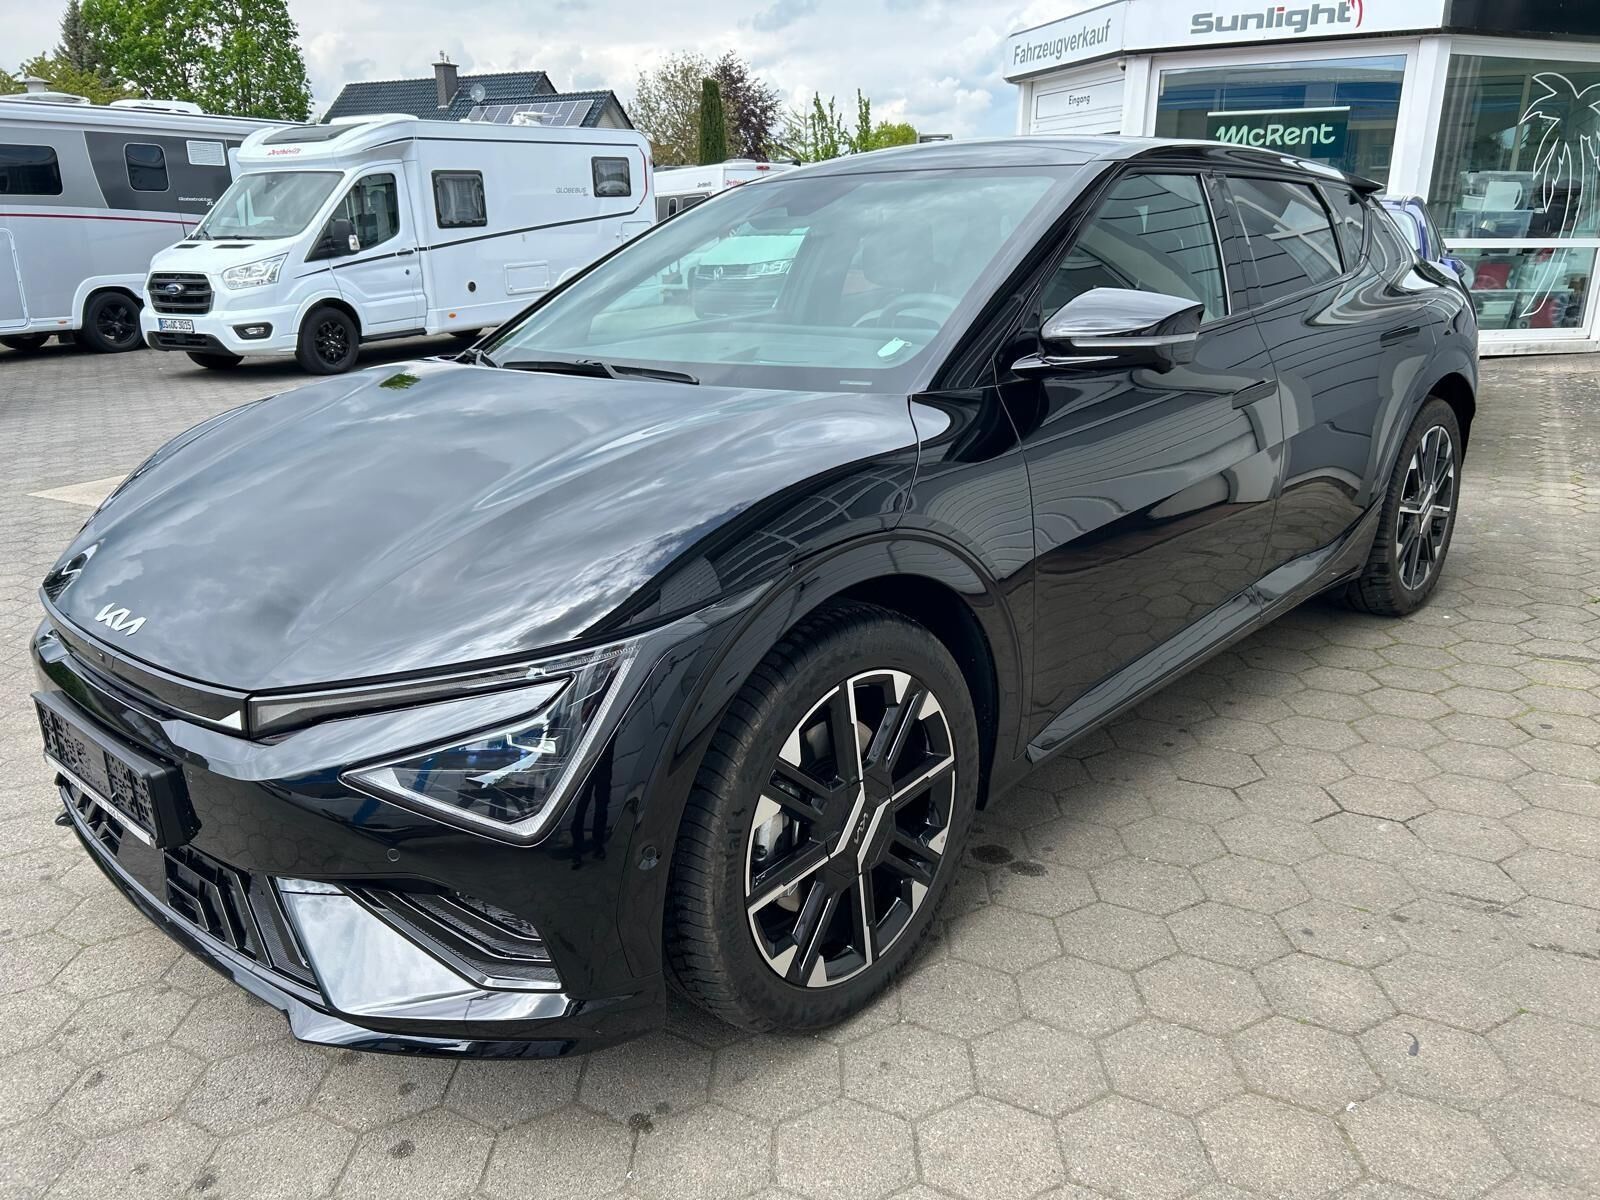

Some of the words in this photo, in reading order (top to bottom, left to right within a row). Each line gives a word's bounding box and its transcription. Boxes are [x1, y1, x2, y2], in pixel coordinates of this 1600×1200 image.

[1190, 1, 1352, 35] Sunlight
[1013, 18, 1112, 66] Fahrzeugverkauf
[1068, 95, 1091, 106] Eingang
[1215, 123, 1336, 147] McRent
[94, 602, 147, 637] KIA
